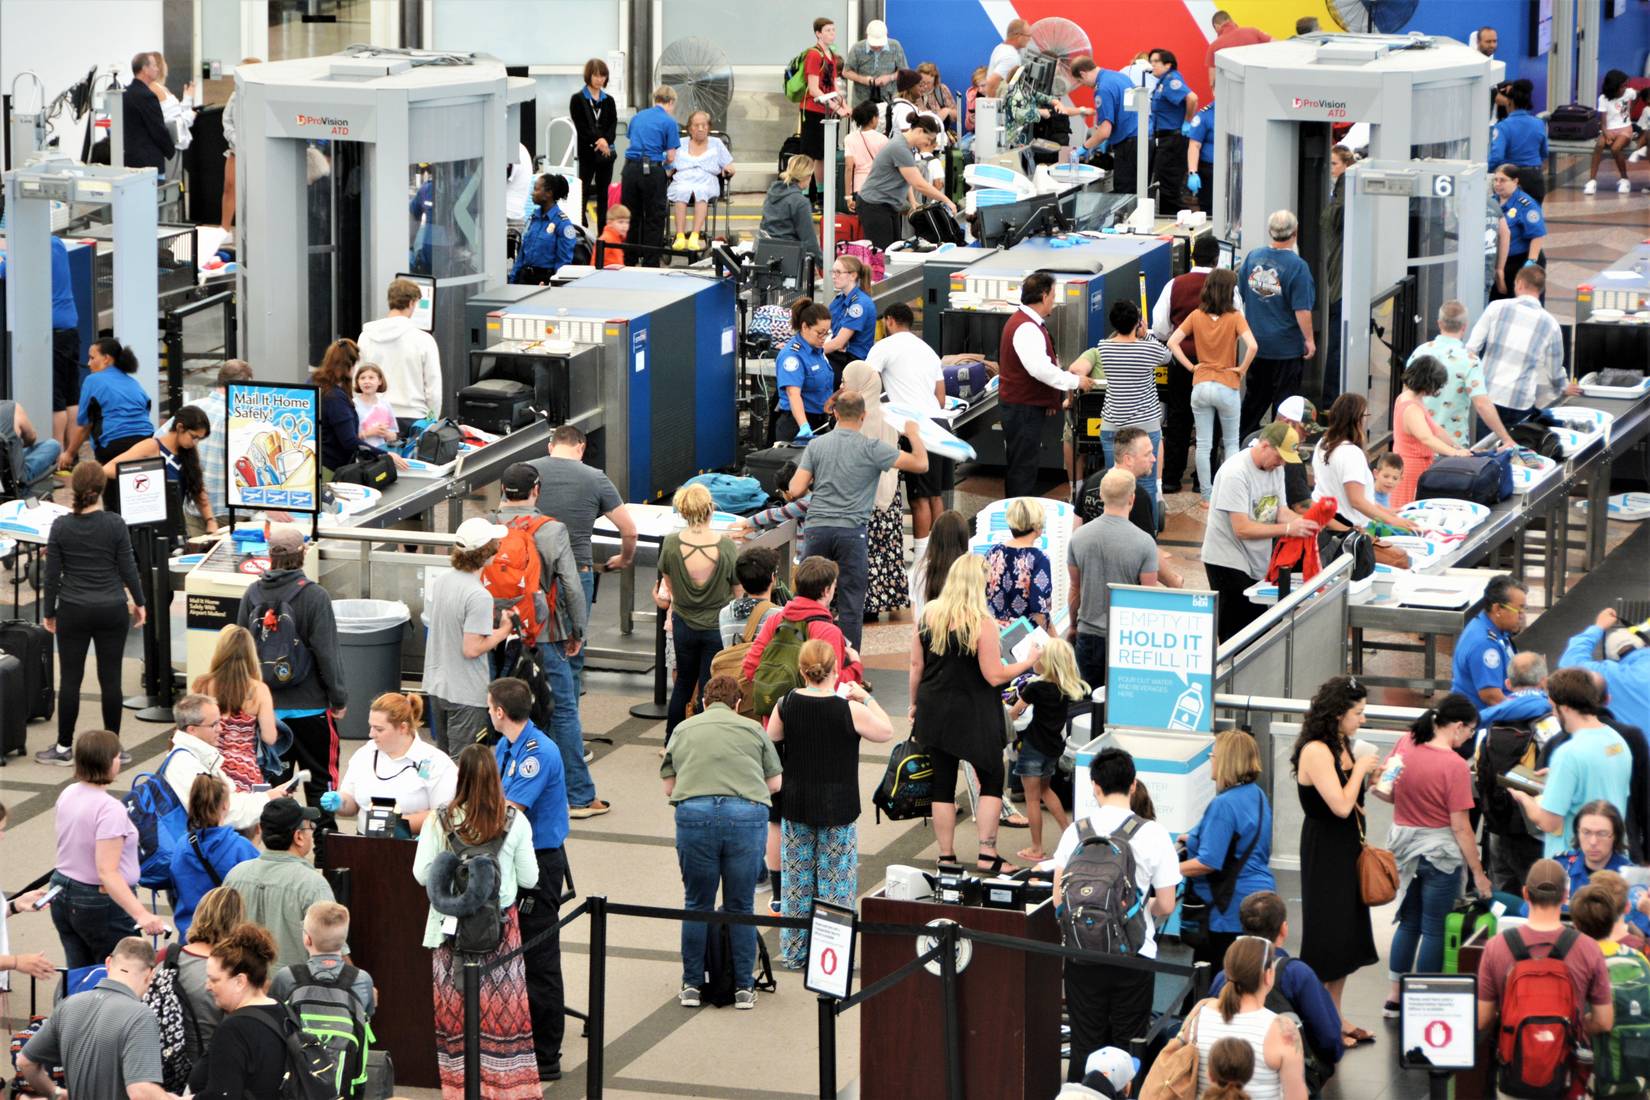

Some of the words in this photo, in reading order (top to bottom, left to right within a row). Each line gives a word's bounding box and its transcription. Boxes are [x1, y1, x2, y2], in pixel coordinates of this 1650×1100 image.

[1304, 99, 1346, 109] ProVision
[306, 116, 349, 126] ProVision
[1328, 109, 1346, 117] ATD
[331, 127, 349, 135] ATD
[1435, 175, 1452, 196] 6
[234, 392, 258, 405] Mail
[262, 394, 270, 406] It
[273, 395, 309, 408] Home
[235, 406, 273, 423] Safely!
[1120, 611, 1182, 629] EMPTY
[1187, 616, 1203, 631] IT
[1120, 629, 1177, 649] HOLD
[1184, 634, 1202, 651] IT
[1119, 648, 1180, 668] REFILL
[1186, 654, 1202, 669] IT
